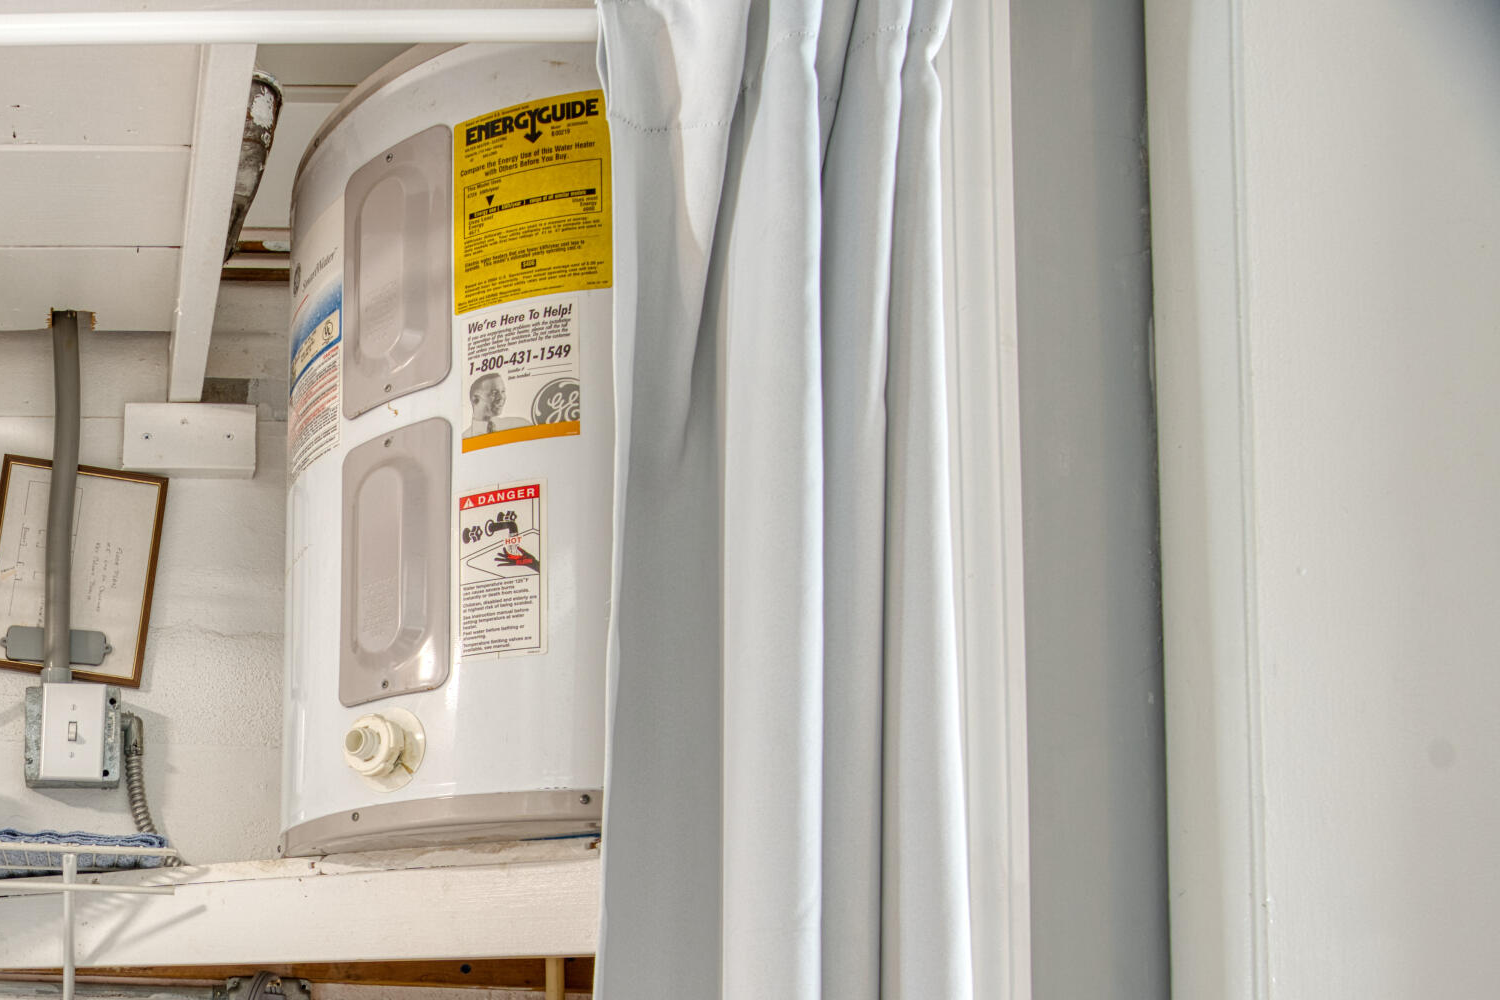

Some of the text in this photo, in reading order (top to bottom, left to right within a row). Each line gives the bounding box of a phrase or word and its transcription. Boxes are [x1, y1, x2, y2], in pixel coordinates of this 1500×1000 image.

[465, 98, 599, 146] ENERGYGUIDE
[460, 163, 485, 177] Compare
[498, 155, 518, 166] Energy
[520, 151, 532, 159] Use
[533, 149, 540, 157] of
[541, 147, 553, 155] this
[554, 144, 573, 153] Water
[575, 141, 596, 150] Heater
[484, 169, 497, 178] with
[498, 163, 518, 173] Others
[520, 158, 540, 168] Before
[555, 153, 570, 162] Buy.
[468, 303, 572, 334] We're Here To Help!
[469, 344, 572, 376] 1-800-431-1549
[478, 487, 535, 505] DANGER
